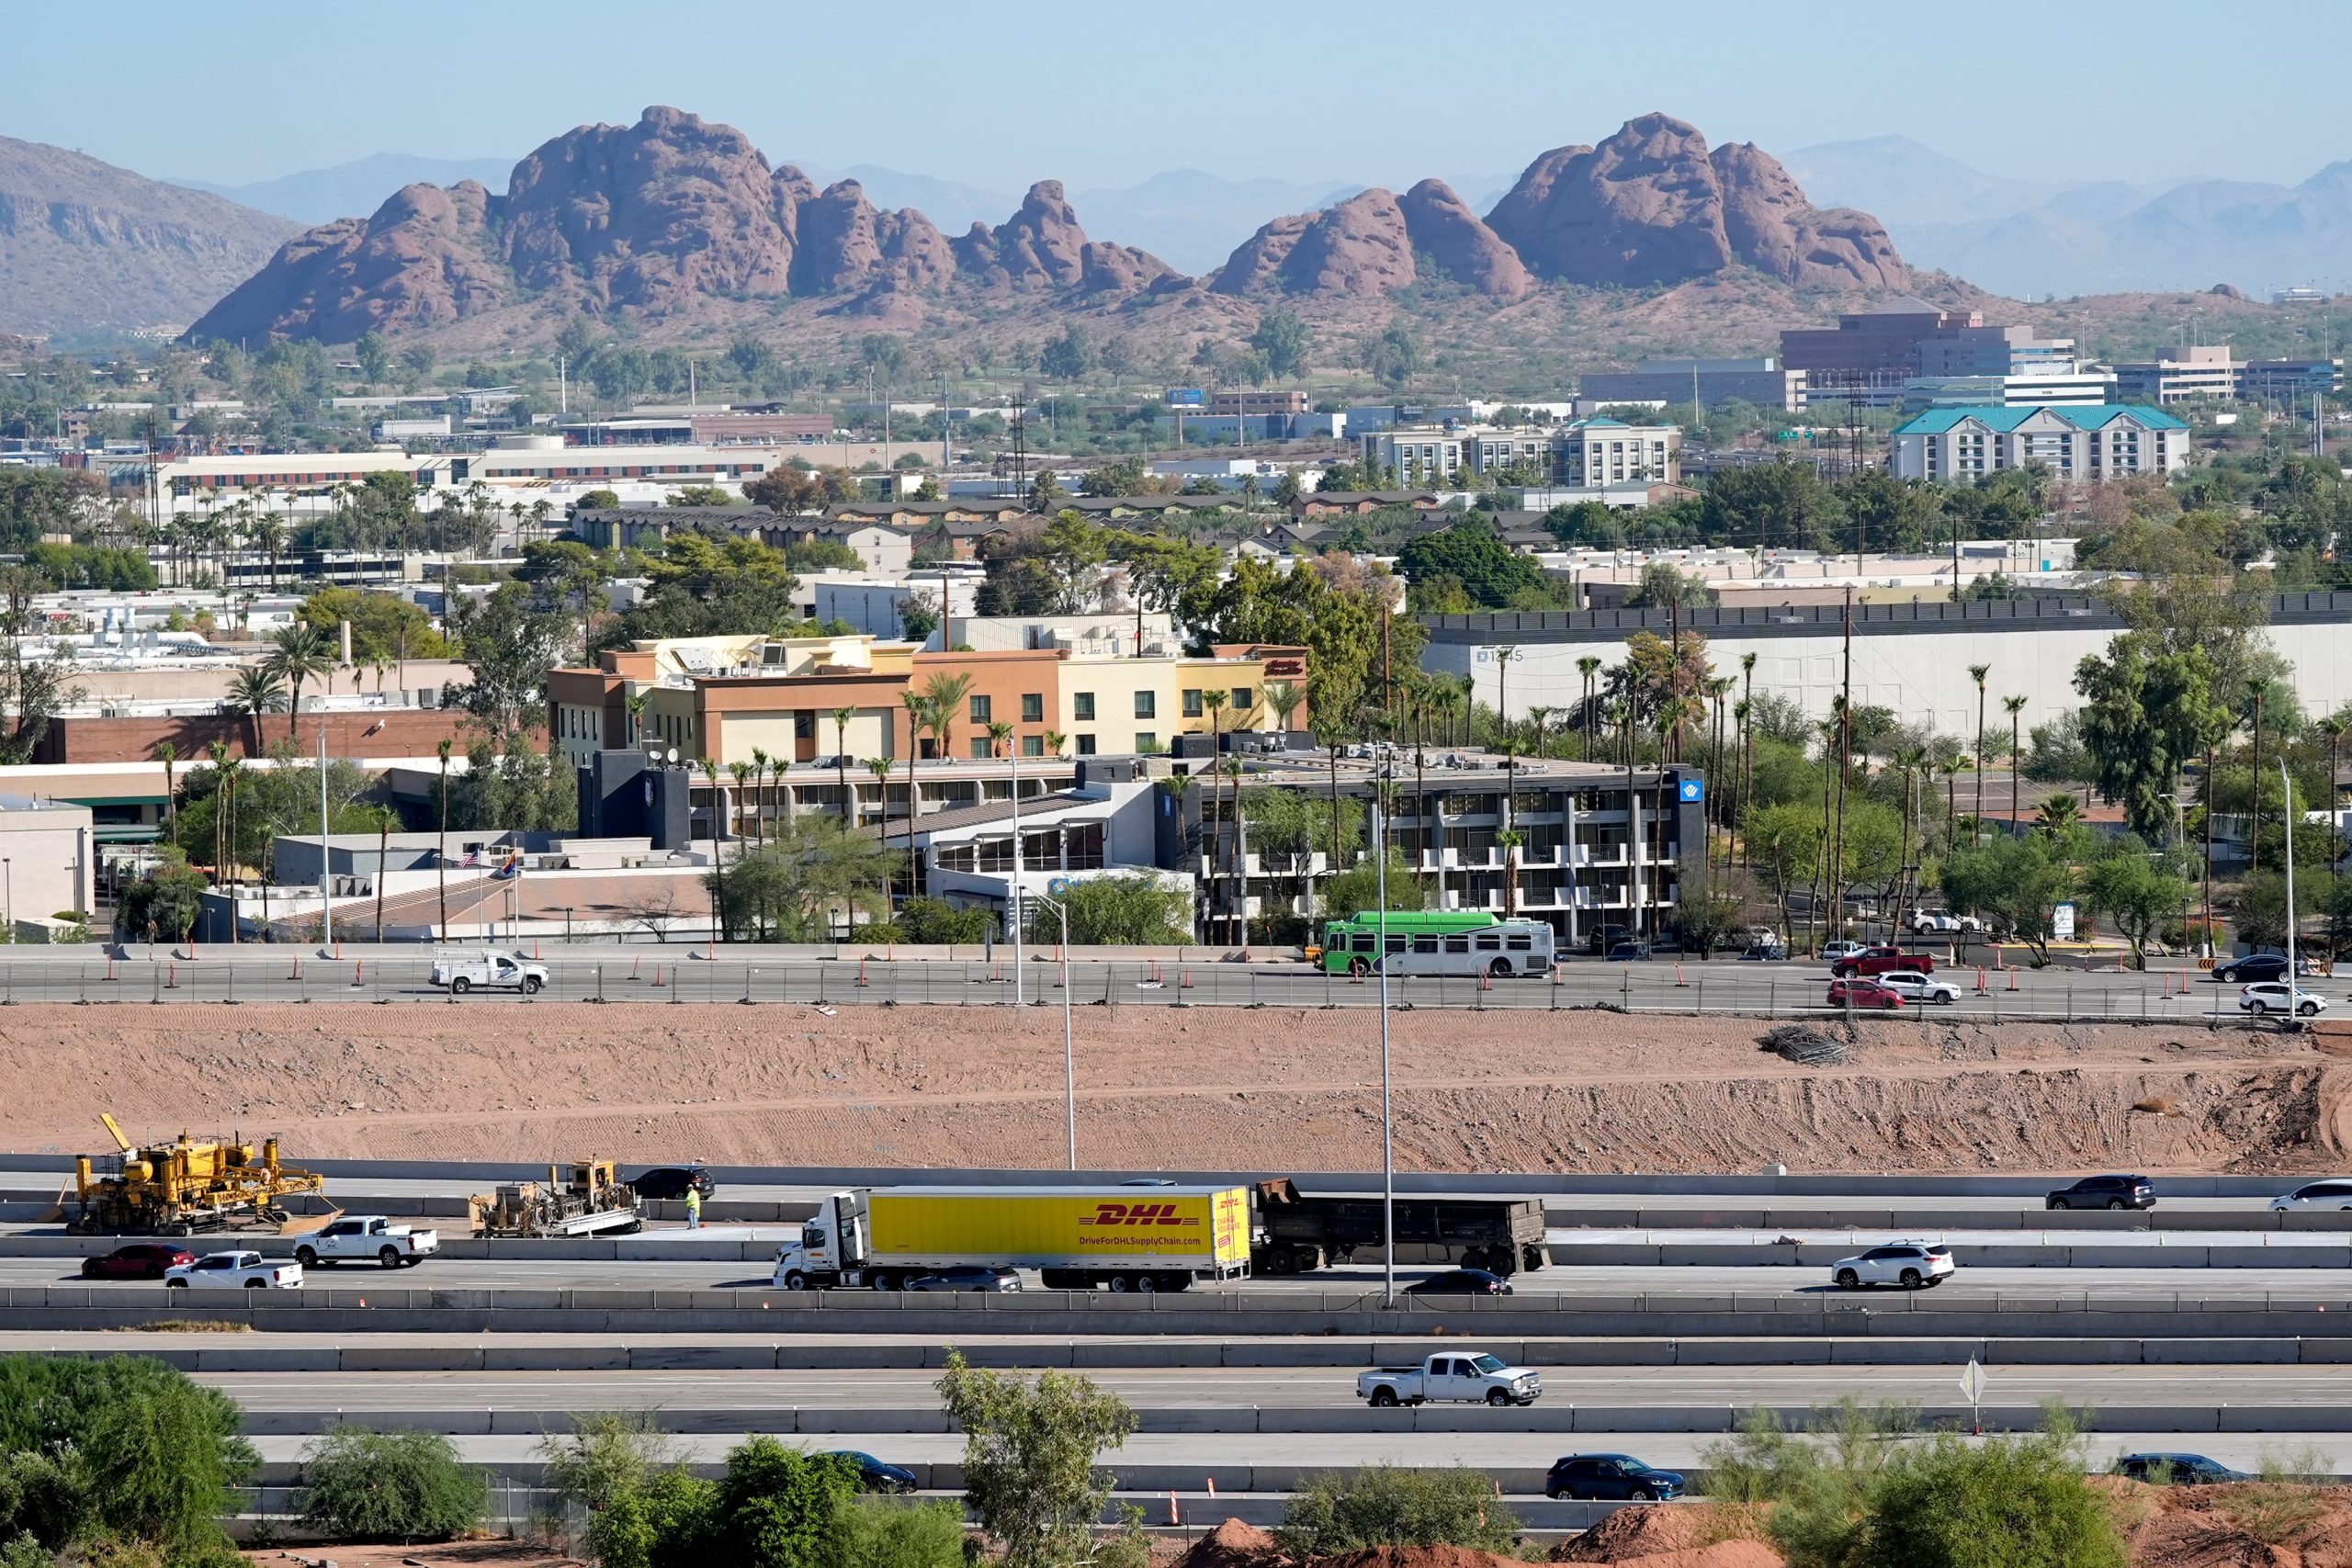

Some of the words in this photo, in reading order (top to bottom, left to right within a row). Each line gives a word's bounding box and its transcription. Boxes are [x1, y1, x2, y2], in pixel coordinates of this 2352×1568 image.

[1220, 1198, 1239, 1210] DHL
[1095, 1204, 1182, 1225] DHL
[1080, 1236, 1201, 1247] DriveForDHLSupplyChain.com
